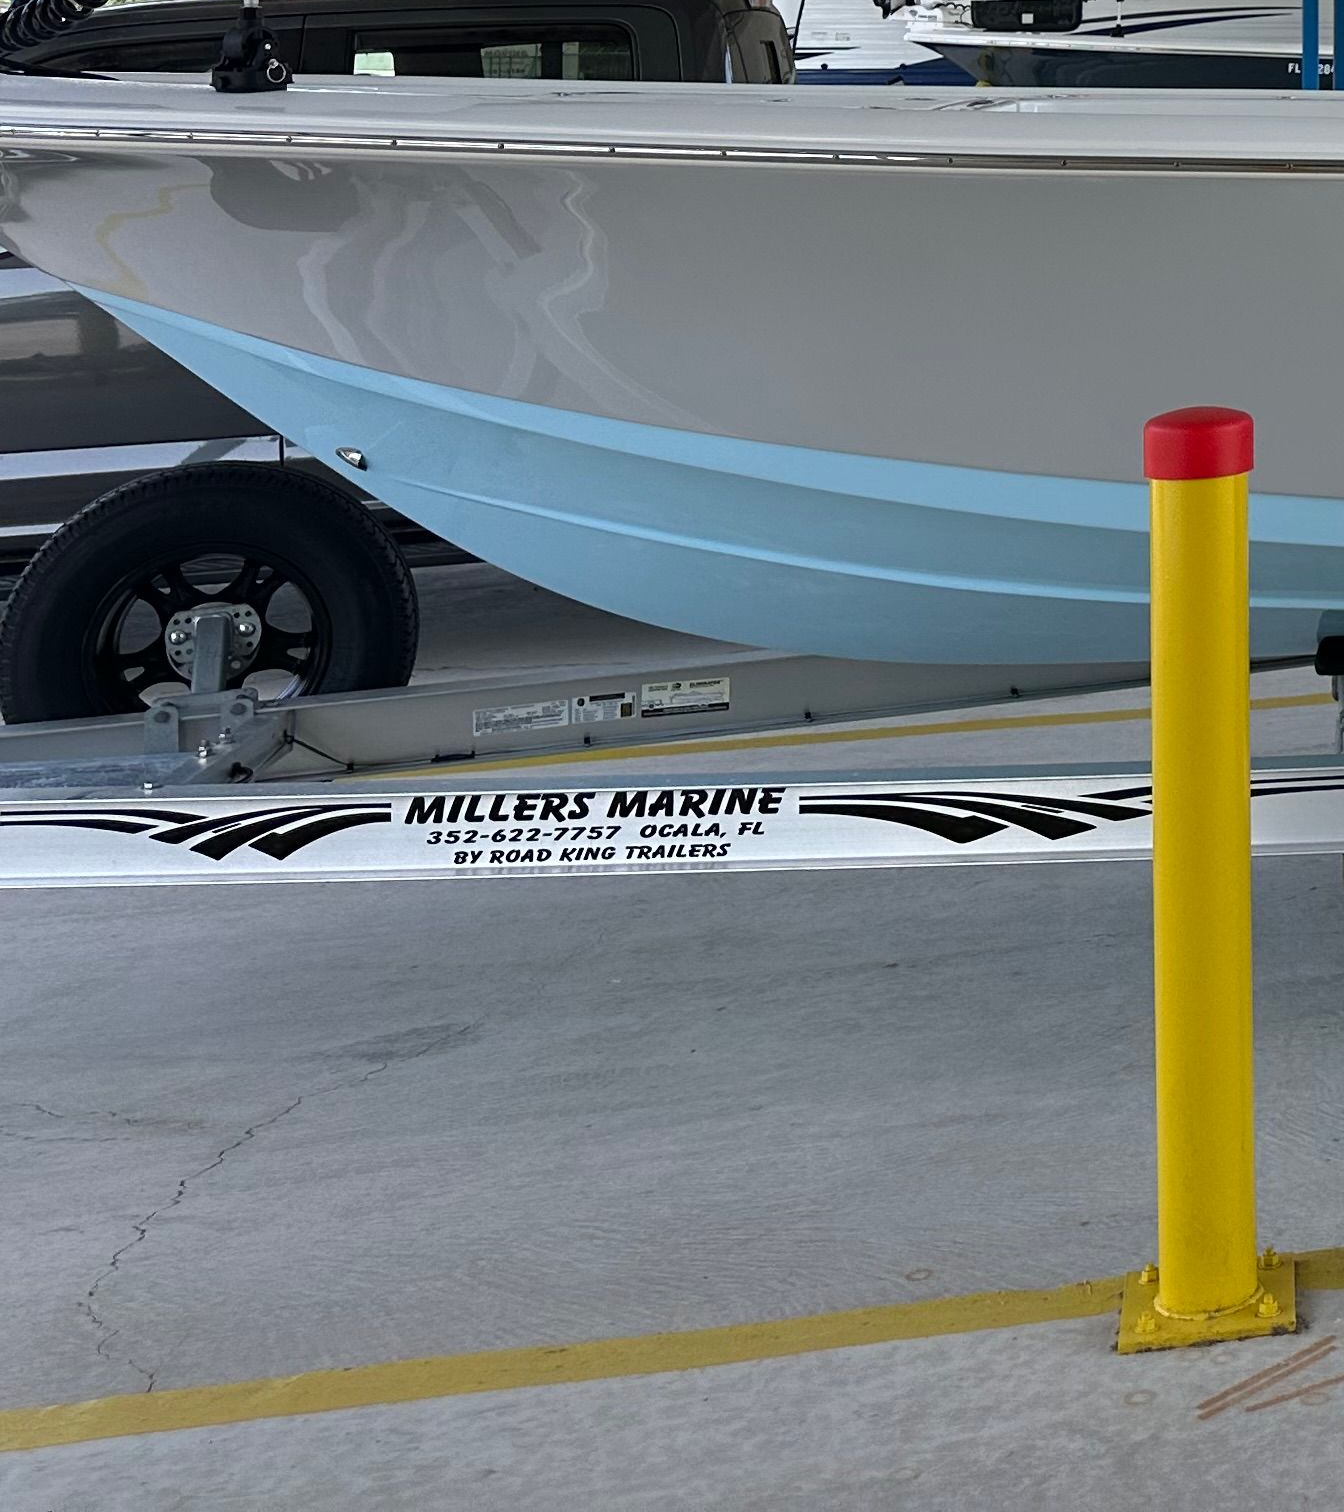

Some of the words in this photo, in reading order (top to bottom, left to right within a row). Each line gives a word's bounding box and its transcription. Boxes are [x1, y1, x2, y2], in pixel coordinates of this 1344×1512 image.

[1287, 62, 1301, 74] FL
[404, 792, 596, 825] MILLERS
[606, 788, 787, 819] MARINE
[426, 825, 622, 845] 352-622-7757
[639, 823, 727, 840] OCALA,
[738, 821, 765, 837] FL
[454, 850, 483, 865] BY
[489, 848, 552, 864] ROAD
[559, 846, 617, 862] KING
[625, 843, 731, 861] TRAILERS
